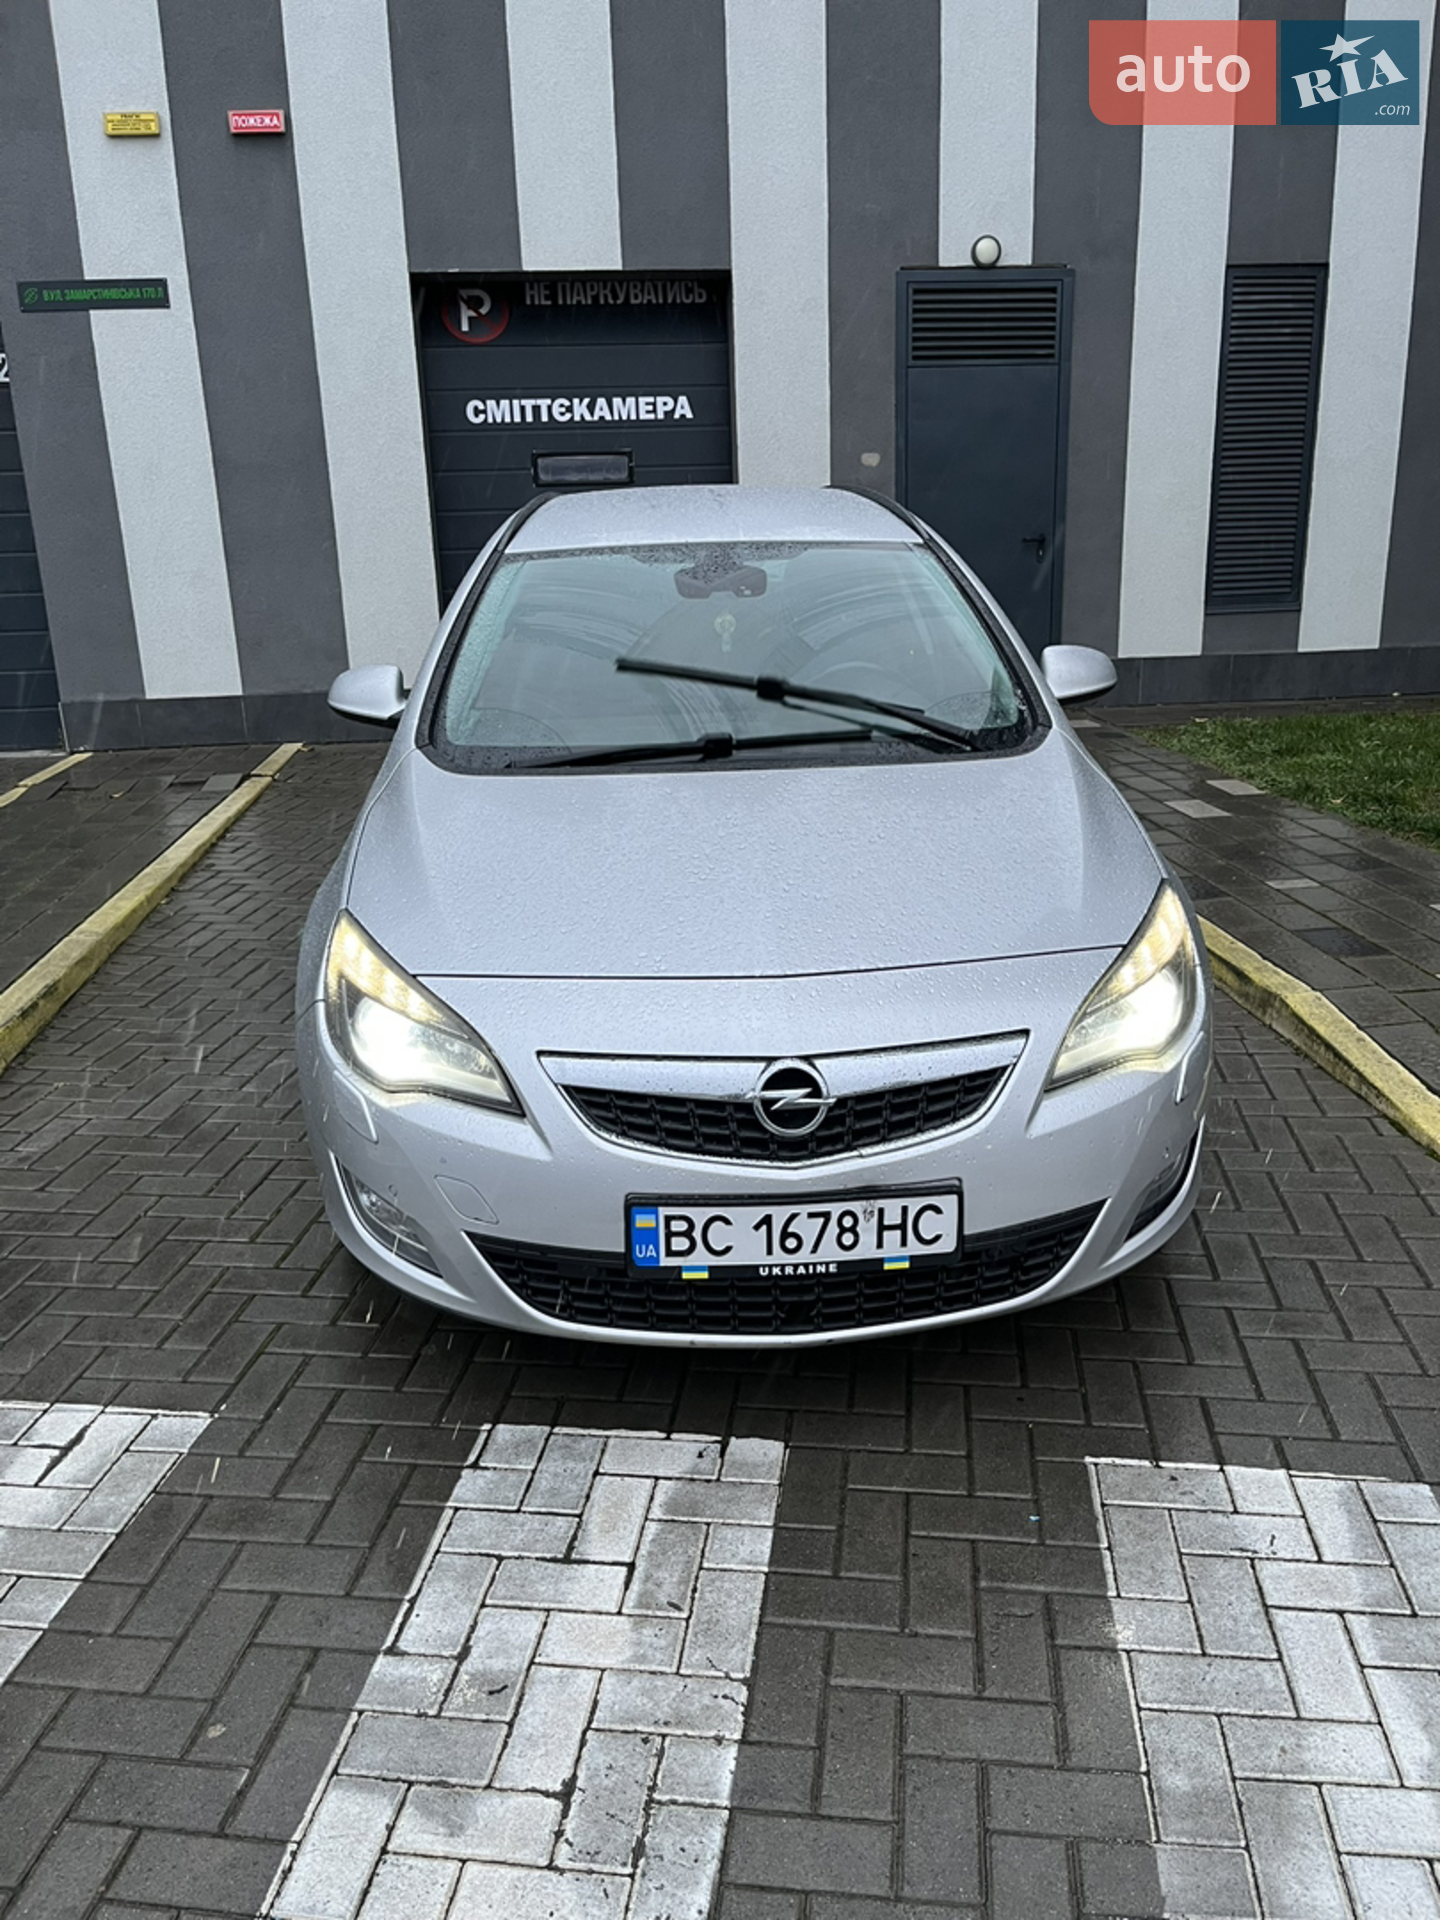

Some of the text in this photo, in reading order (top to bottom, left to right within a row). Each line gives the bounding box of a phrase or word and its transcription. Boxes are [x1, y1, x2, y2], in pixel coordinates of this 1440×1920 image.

[232, 115, 280, 128] ПОЖЕЖА
[524, 281, 553, 306] НЕ
[465, 395, 694, 425] СМІТТЄКАМЕРА
[663, 1203, 944, 1259] BC 1678 HC
[636, 1244, 658, 1259] UA
[759, 1262, 839, 1276] UKRAINE
